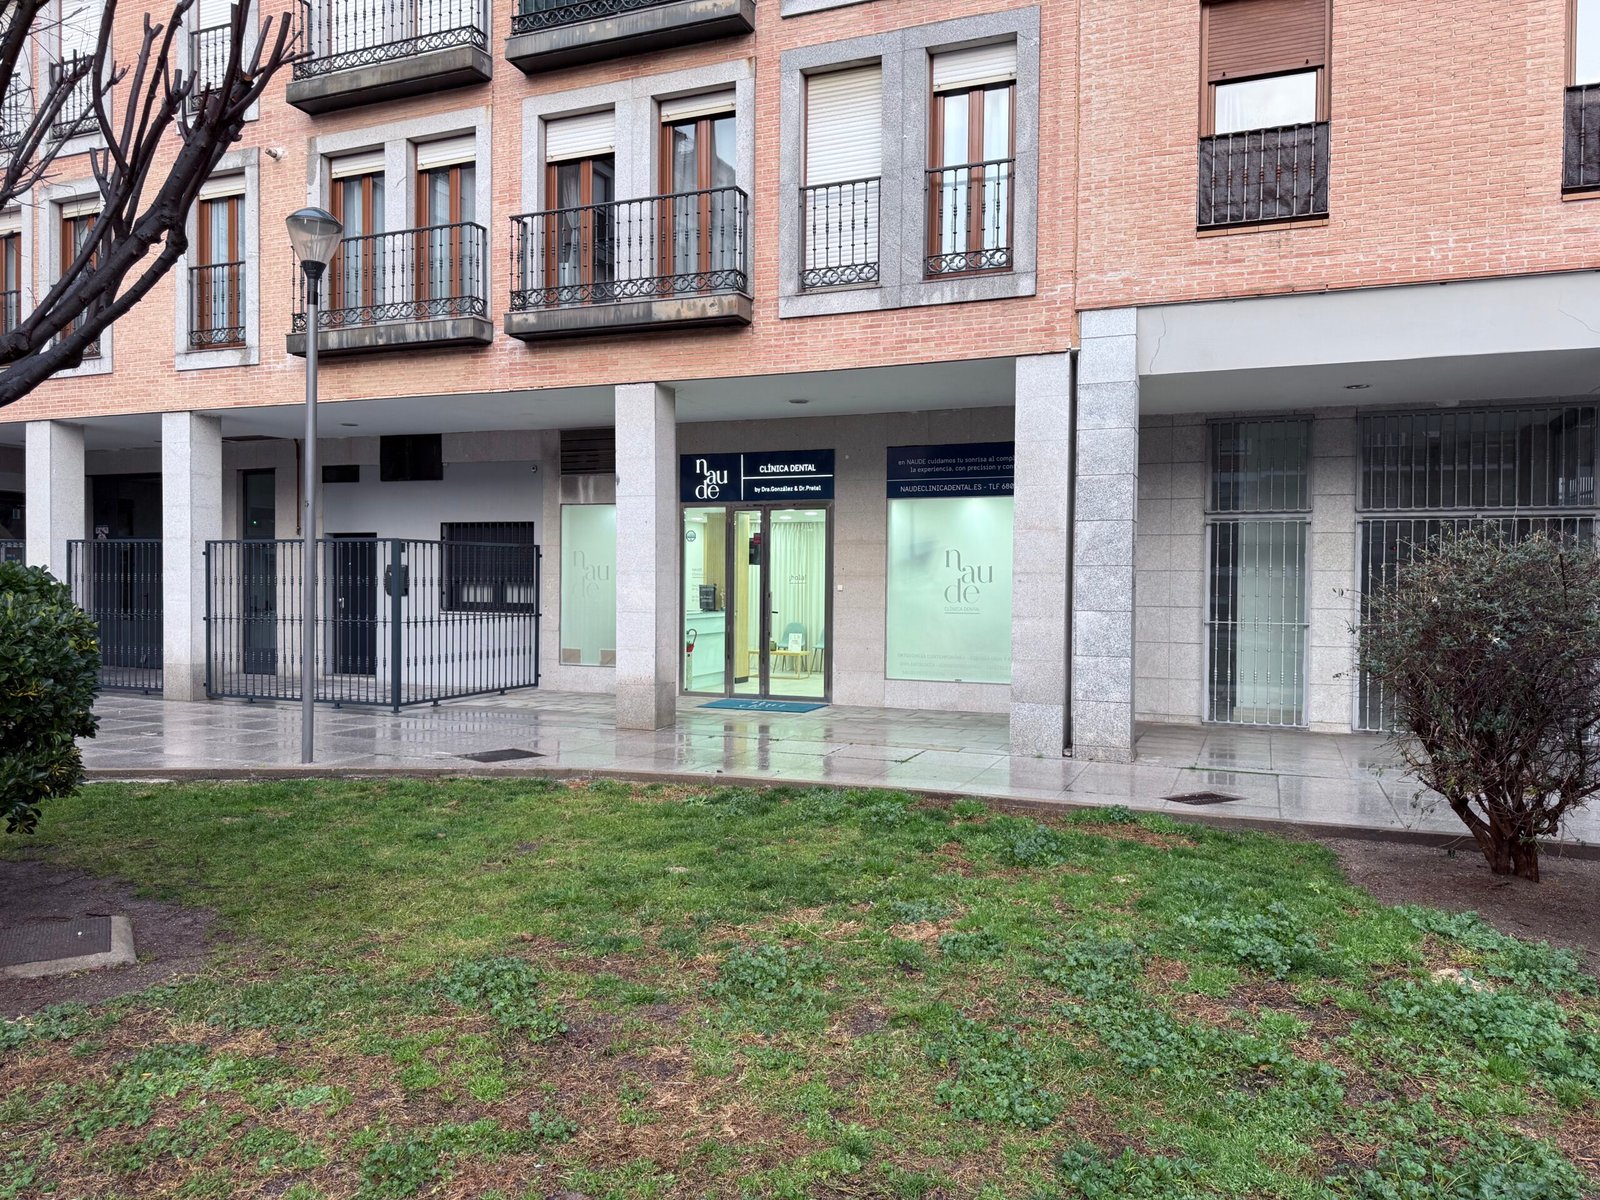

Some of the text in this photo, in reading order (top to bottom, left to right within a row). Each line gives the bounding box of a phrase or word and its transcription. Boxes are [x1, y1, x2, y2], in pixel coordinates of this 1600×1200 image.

[759, 463, 816, 473] CLÍNICA DENTAL
[754, 486, 760, 494] by
[900, 483, 982, 493] NAUDECLINICADENTAL.ES
[989, 483, 1000, 491] TLF
